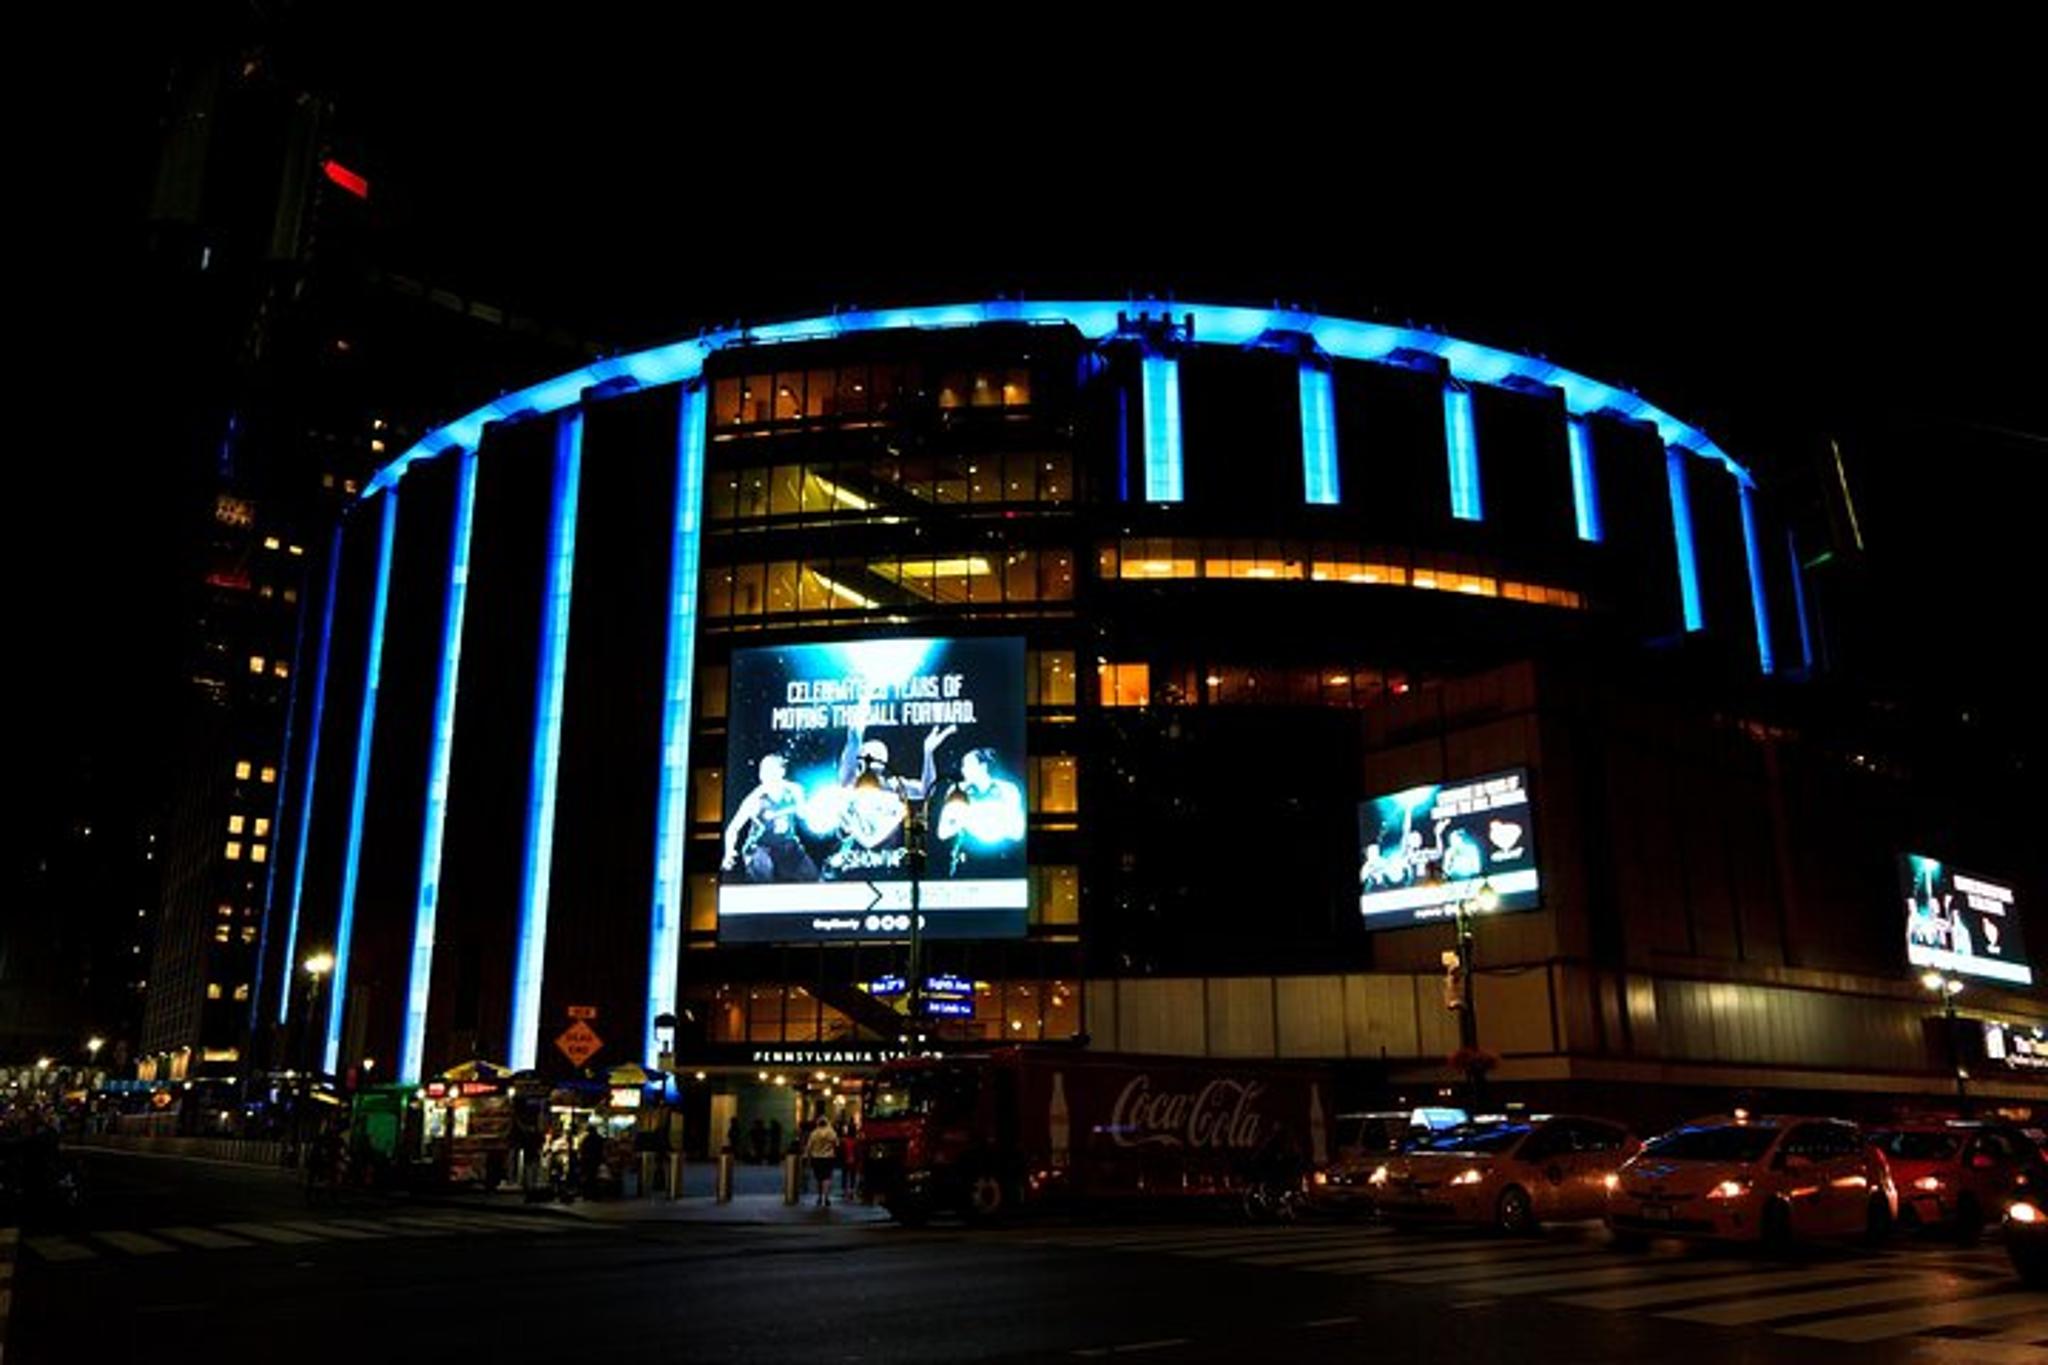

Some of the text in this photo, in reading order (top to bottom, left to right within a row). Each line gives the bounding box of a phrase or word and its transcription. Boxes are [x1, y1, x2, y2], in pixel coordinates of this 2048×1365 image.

[787, 679, 870, 703] CELEBRAT
[943, 675, 963, 697] OF
[753, 1051, 944, 1062] PENNSYLVANIA STAON
[1111, 1073, 1270, 1149] Coca-Cola
